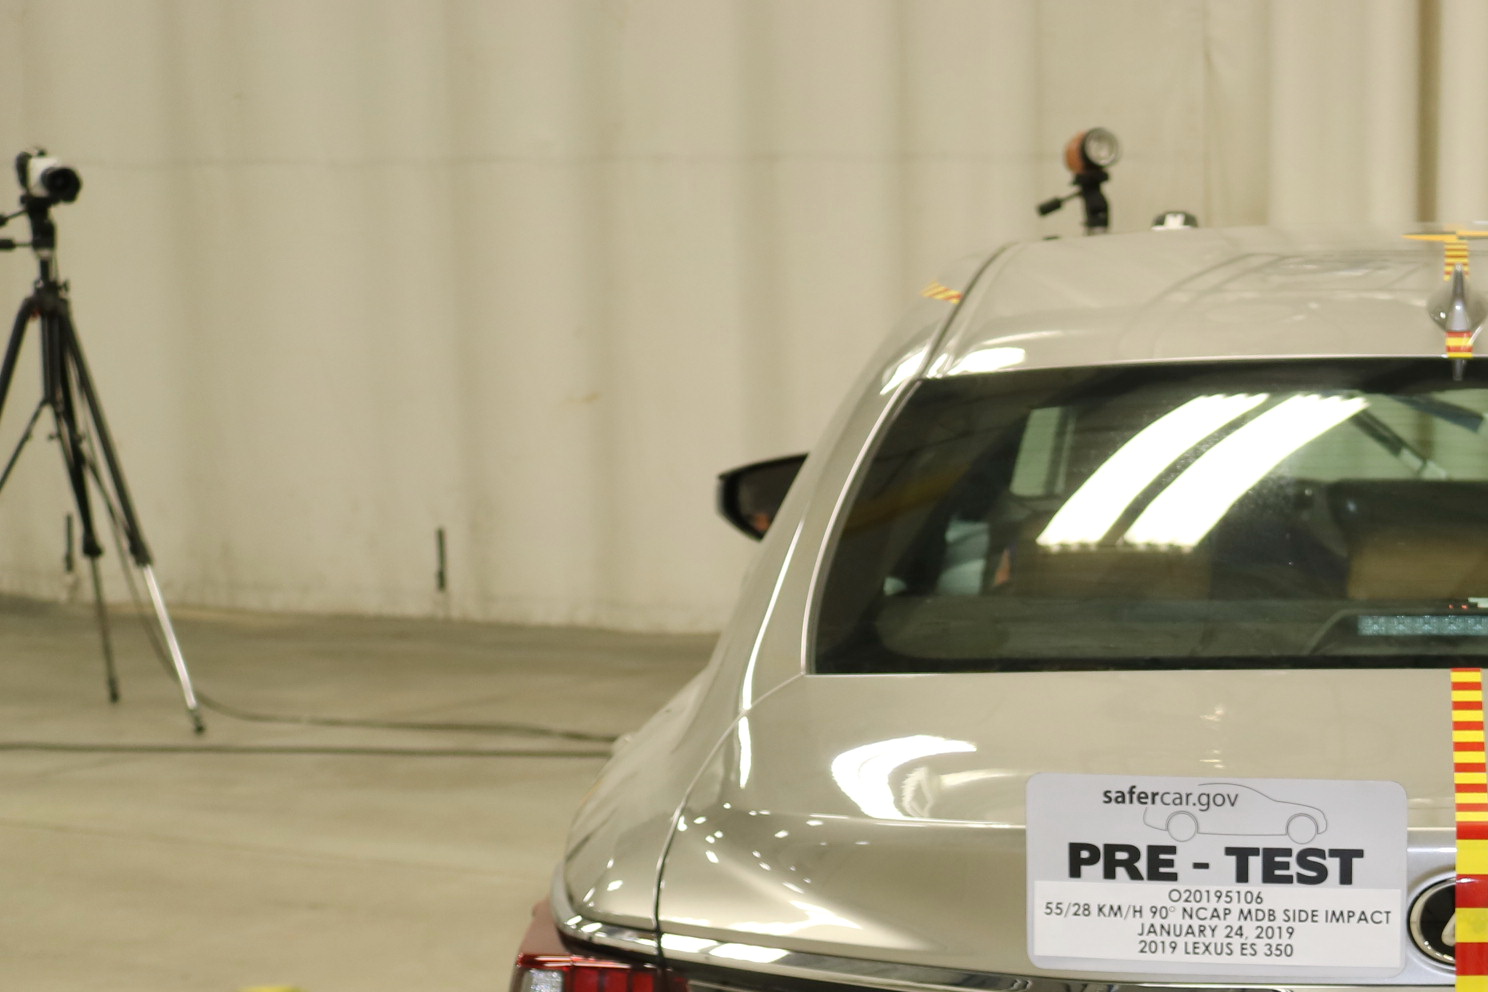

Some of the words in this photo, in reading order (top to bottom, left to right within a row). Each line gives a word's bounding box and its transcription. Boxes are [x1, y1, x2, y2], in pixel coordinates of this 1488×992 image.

[1102, 785, 1239, 812] safercar.gov
[1068, 842, 1178, 882] PRE
[1224, 846, 1364, 886] TEST
[1044, 901, 1091, 918] 55/28
[1097, 904, 1143, 920] KM/H
[1182, 906, 1232, 921] NCAP
[1237, 907, 1276, 922] MDB
[1282, 909, 1319, 923] SIDE
[1324, 909, 1392, 925] IMPACT
[1137, 922, 1218, 938] JANUARY
[1224, 925, 1249, 940] 24,
[1254, 925, 1295, 940] 2019
[1138, 940, 1178, 954] 2019
[1184, 941, 1233, 956] LEXUS
[1240, 942, 1258, 957] ES
[1263, 943, 1294, 957] 350
